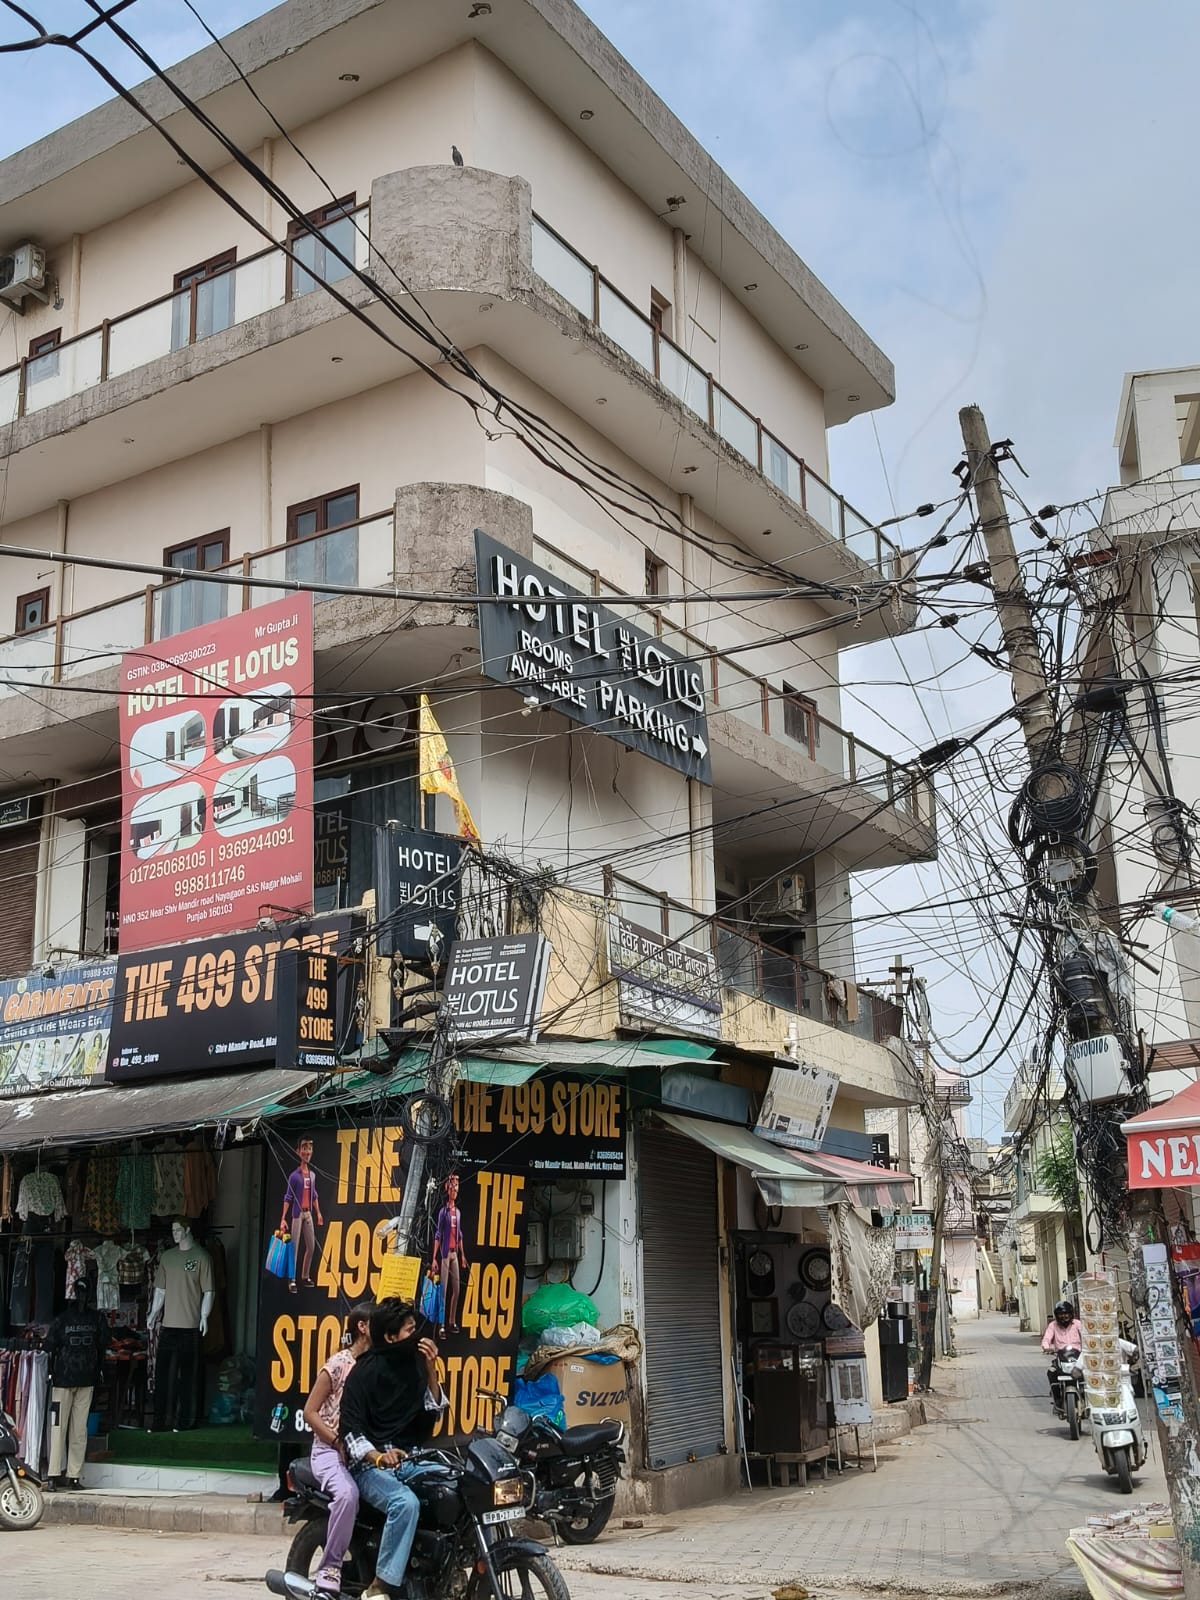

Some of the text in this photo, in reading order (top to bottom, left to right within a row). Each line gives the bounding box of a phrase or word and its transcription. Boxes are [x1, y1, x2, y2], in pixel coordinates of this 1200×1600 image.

[254, 625, 266, 638] Mr
[266, 620, 291, 635] Gupta
[491, 555, 705, 712] HOTEL THE LOTUS
[518, 630, 574, 674] ROOMS
[127, 637, 299, 717] HOTEL THE LOTUS
[509, 655, 689, 752] AVAILABLE PARKING
[130, 850, 207, 885] 01725068105
[218, 826, 294, 862] 9369244091
[398, 846, 454, 874] HOTEL
[136, 909, 149, 922] 352
[150, 905, 164, 918] Near
[164, 901, 178, 914] Shiv
[178, 896, 200, 912] Mandir
[200, 893, 215, 906] road
[246, 882, 260, 895] SAS
[260, 877, 280, 892] Nagar
[280, 872, 303, 888] Mohali
[174, 864, 246, 897] 9988111746
[407, 882, 457, 910] LOTUS
[186, 903, 233, 923] Punjab 160103
[124, 959, 173, 1023] THE
[176, 949, 236, 1014] 499
[308, 956, 327, 981] THE
[450, 961, 520, 985] HOTEL
[3, 979, 114, 1024] GARMENTS
[306, 987, 328, 1010] 499
[459, 989, 518, 1016] LOTUS
[300, 1015, 334, 1041] STORE
[453, 1079, 621, 1138] THE 499 STORE
[336, 1127, 402, 1204] THE
[1140, 1136, 1200, 1178] NE
[477, 1171, 525, 1248] THE
[317, 1219, 398, 1298] 499
[462, 1263, 517, 1339] 499
[270, 1314, 347, 1393] STO
